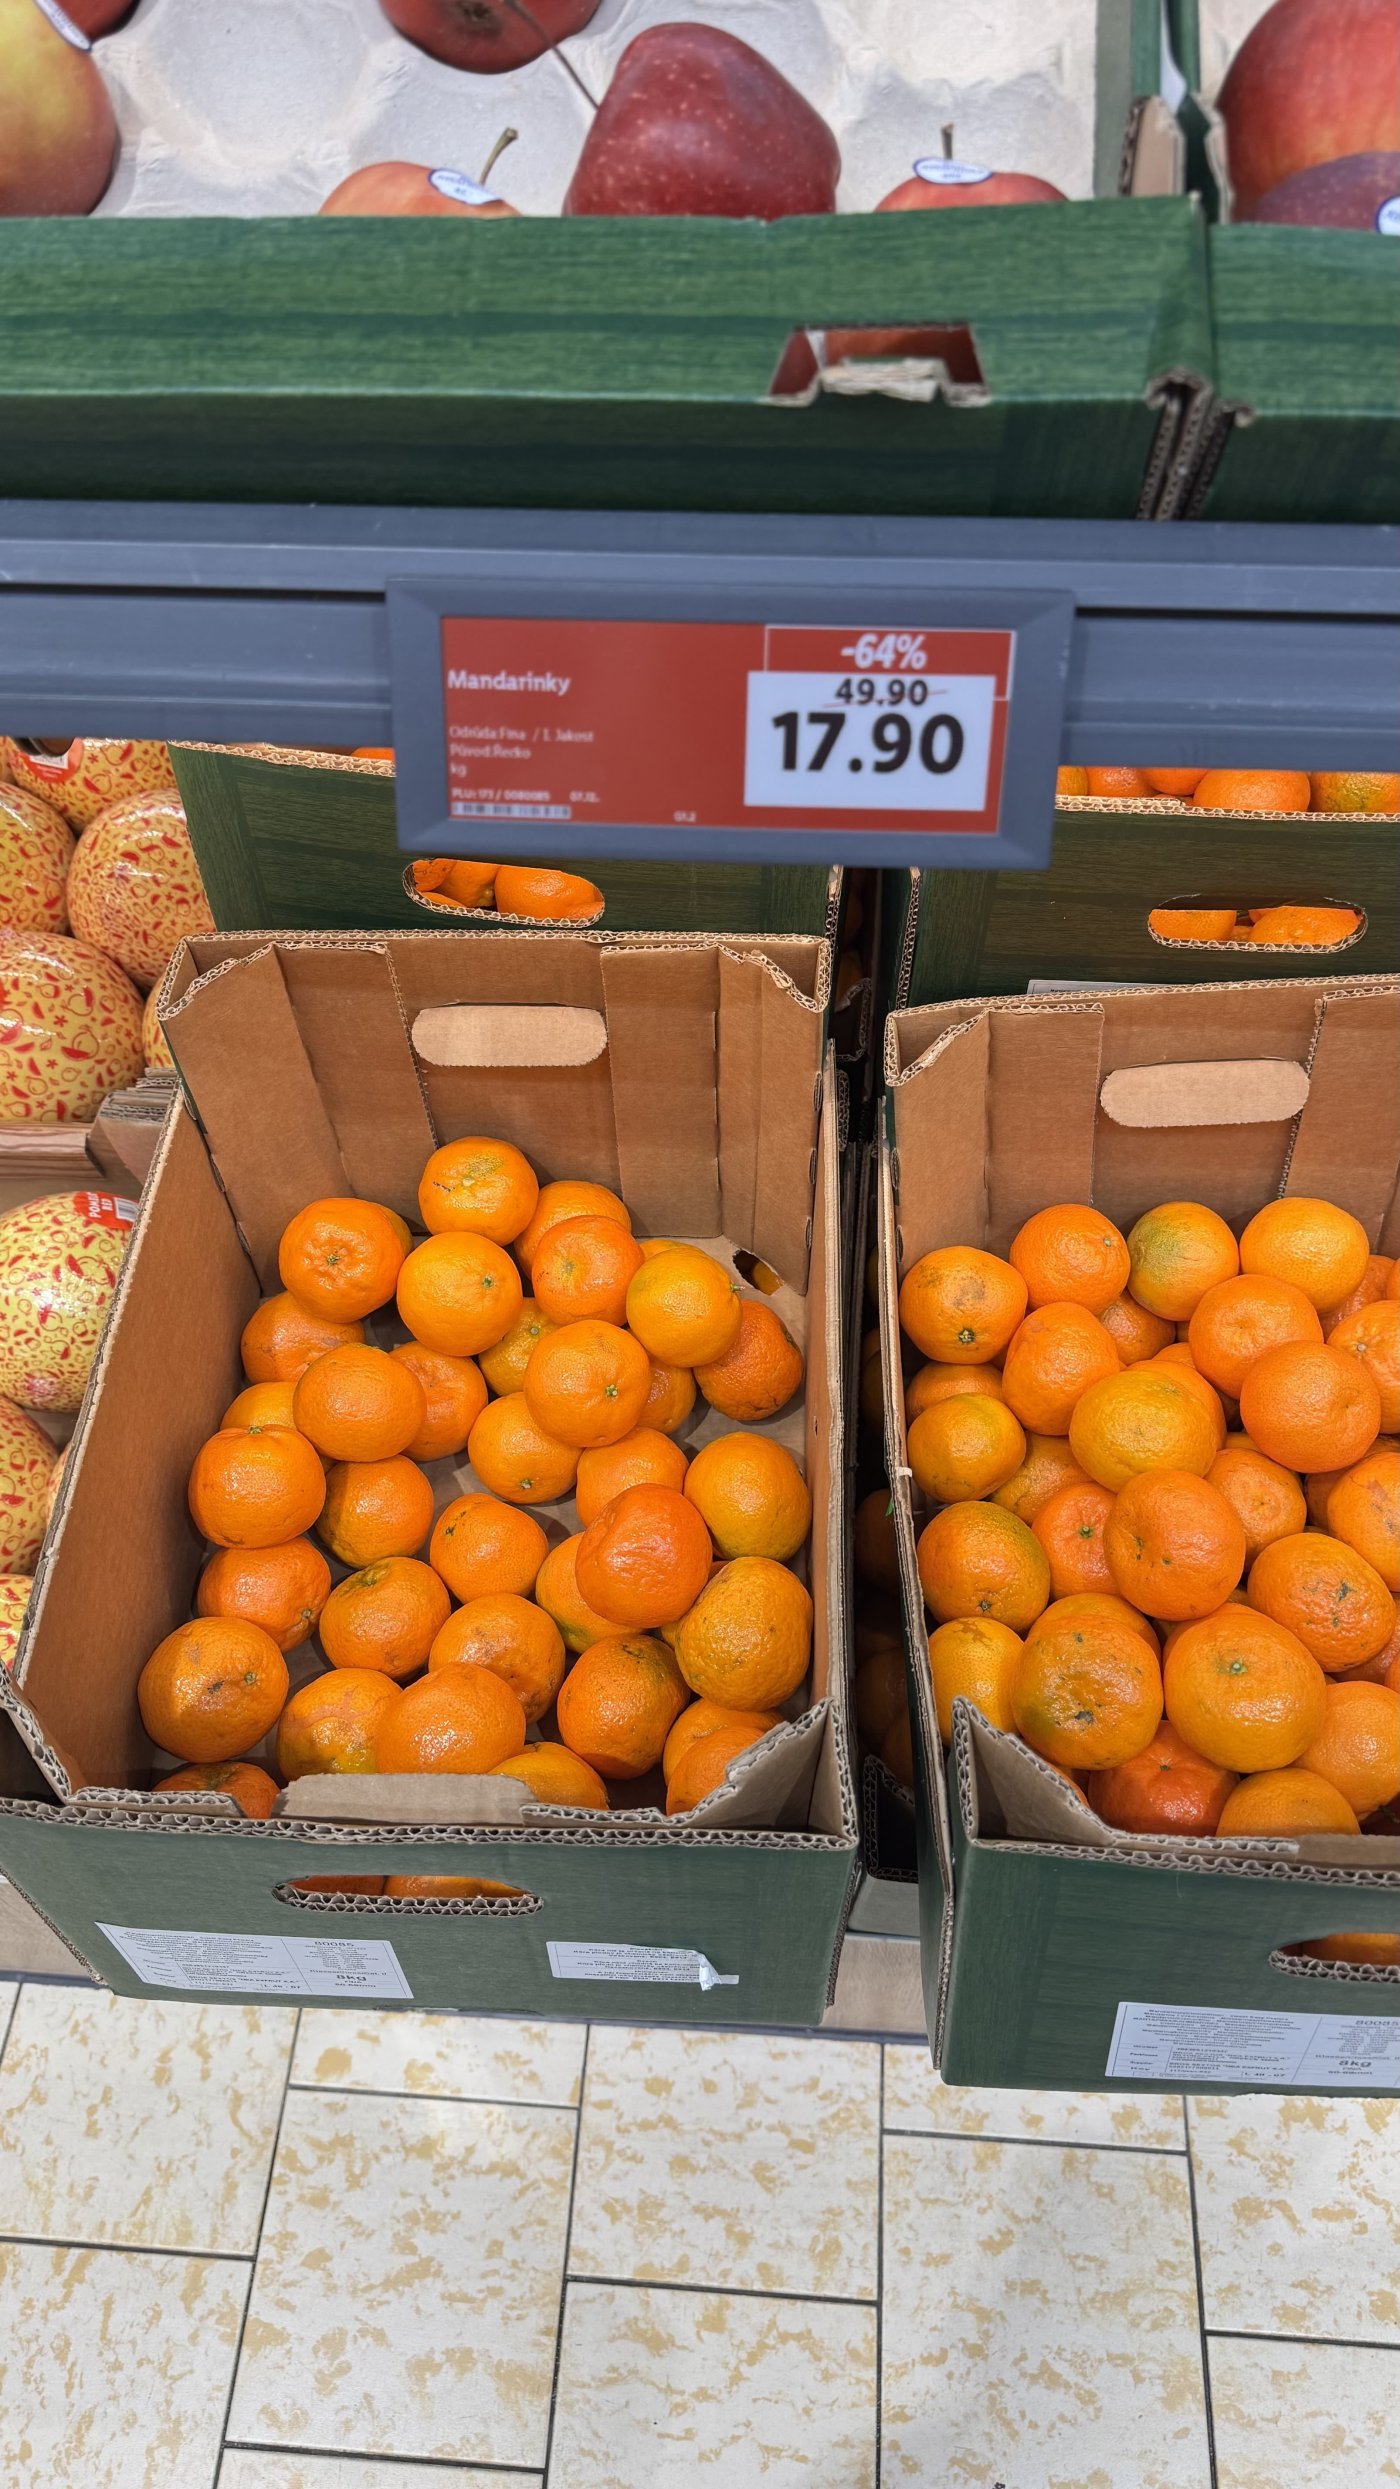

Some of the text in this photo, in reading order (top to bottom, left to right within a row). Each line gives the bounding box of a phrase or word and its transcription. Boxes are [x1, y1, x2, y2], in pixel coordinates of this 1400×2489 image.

[841, 633, 927, 670] -64%
[447, 670, 571, 697] Mandarinky
[835, 678, 929, 707] 49.90
[772, 711, 965, 775] 17.90
[450, 763, 467, 777] kg
[1338, 2060, 1372, 2068] 8kg
